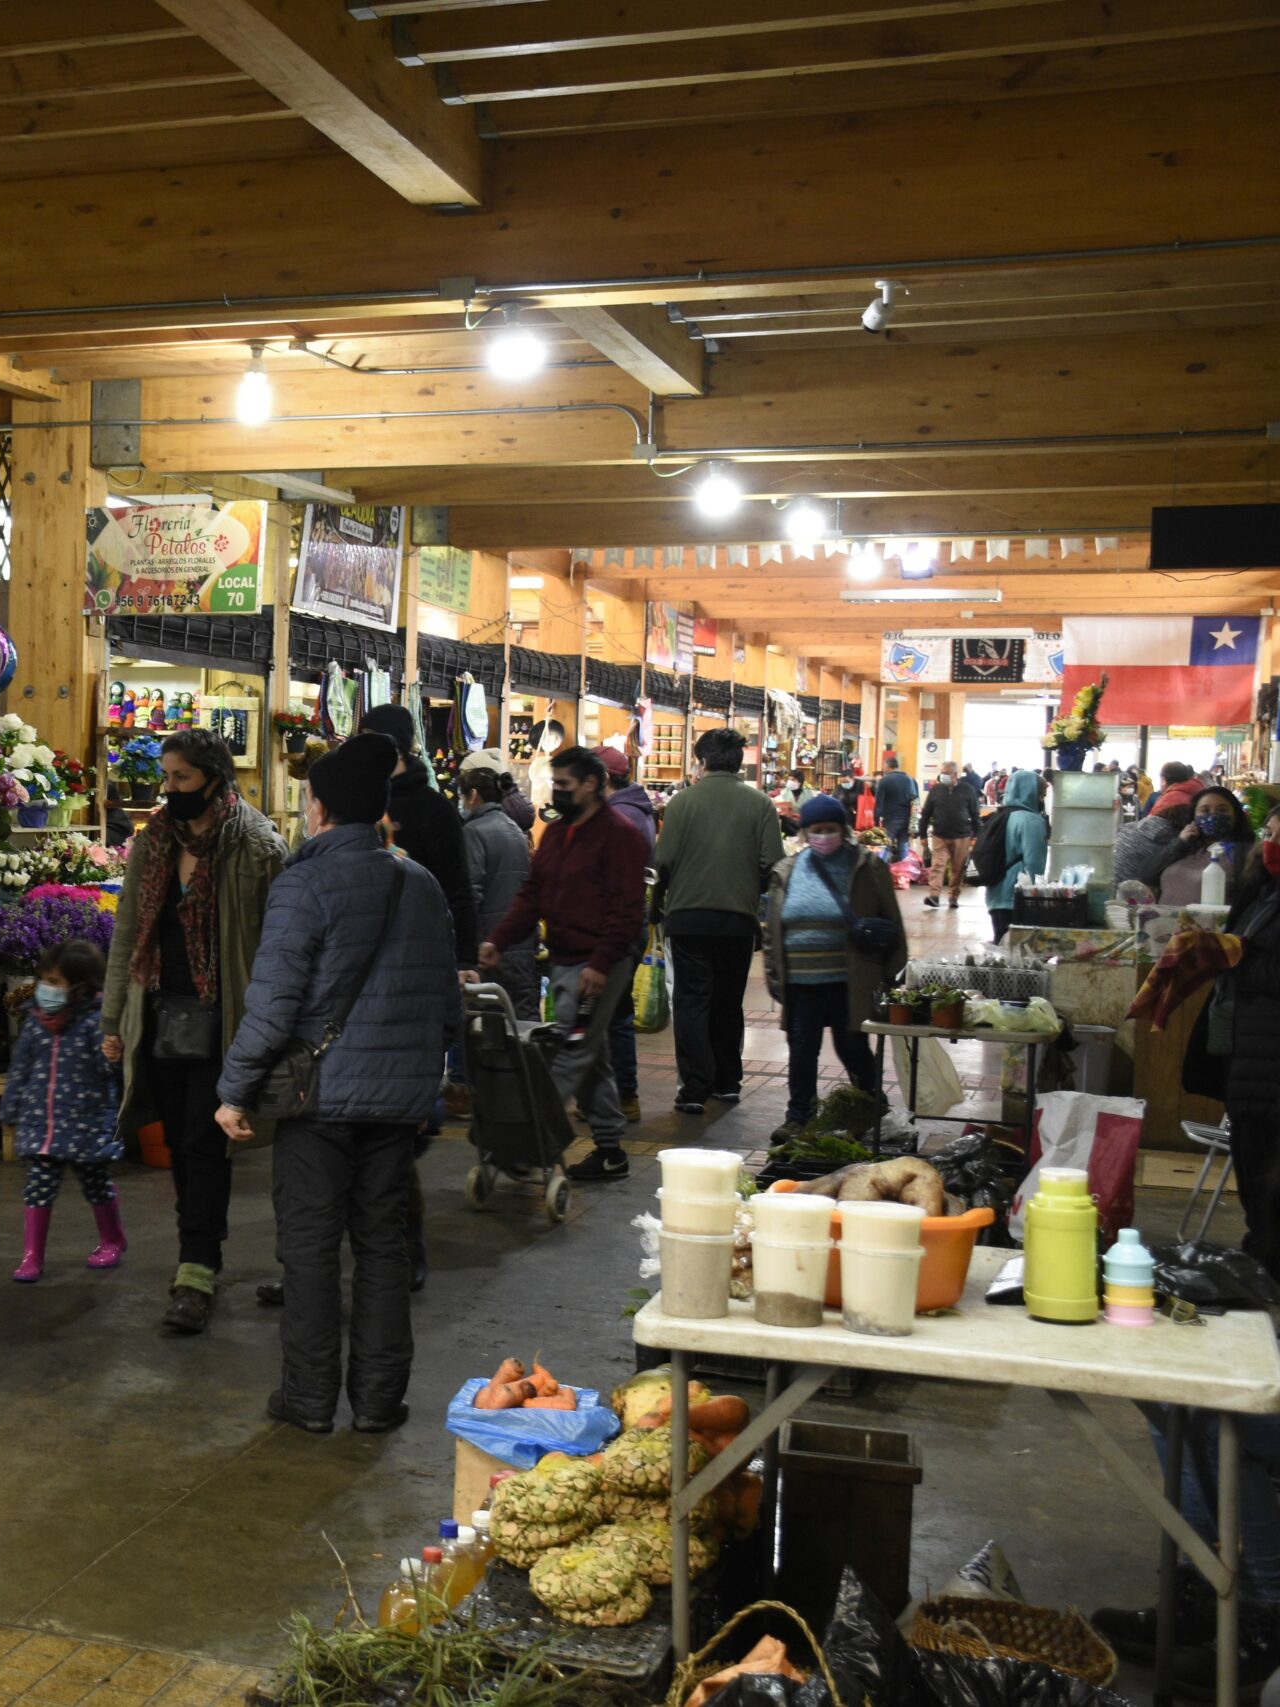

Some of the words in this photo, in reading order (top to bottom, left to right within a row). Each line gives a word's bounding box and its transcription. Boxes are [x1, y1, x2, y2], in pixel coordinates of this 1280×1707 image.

[144, 532, 207, 555] Petalos
[129, 559, 155, 567] PLANTAS
[158, 558, 187, 566] ARREGLOS
[188, 556, 216, 564] FLORALES
[140, 566, 175, 575] ACCESORIOS
[183, 565, 209, 573] GENERAL
[218, 577, 256, 589] LOCAL
[136, 595, 144, 607] 9
[147, 594, 200, 607] 76187243
[227, 592, 245, 607] 70
